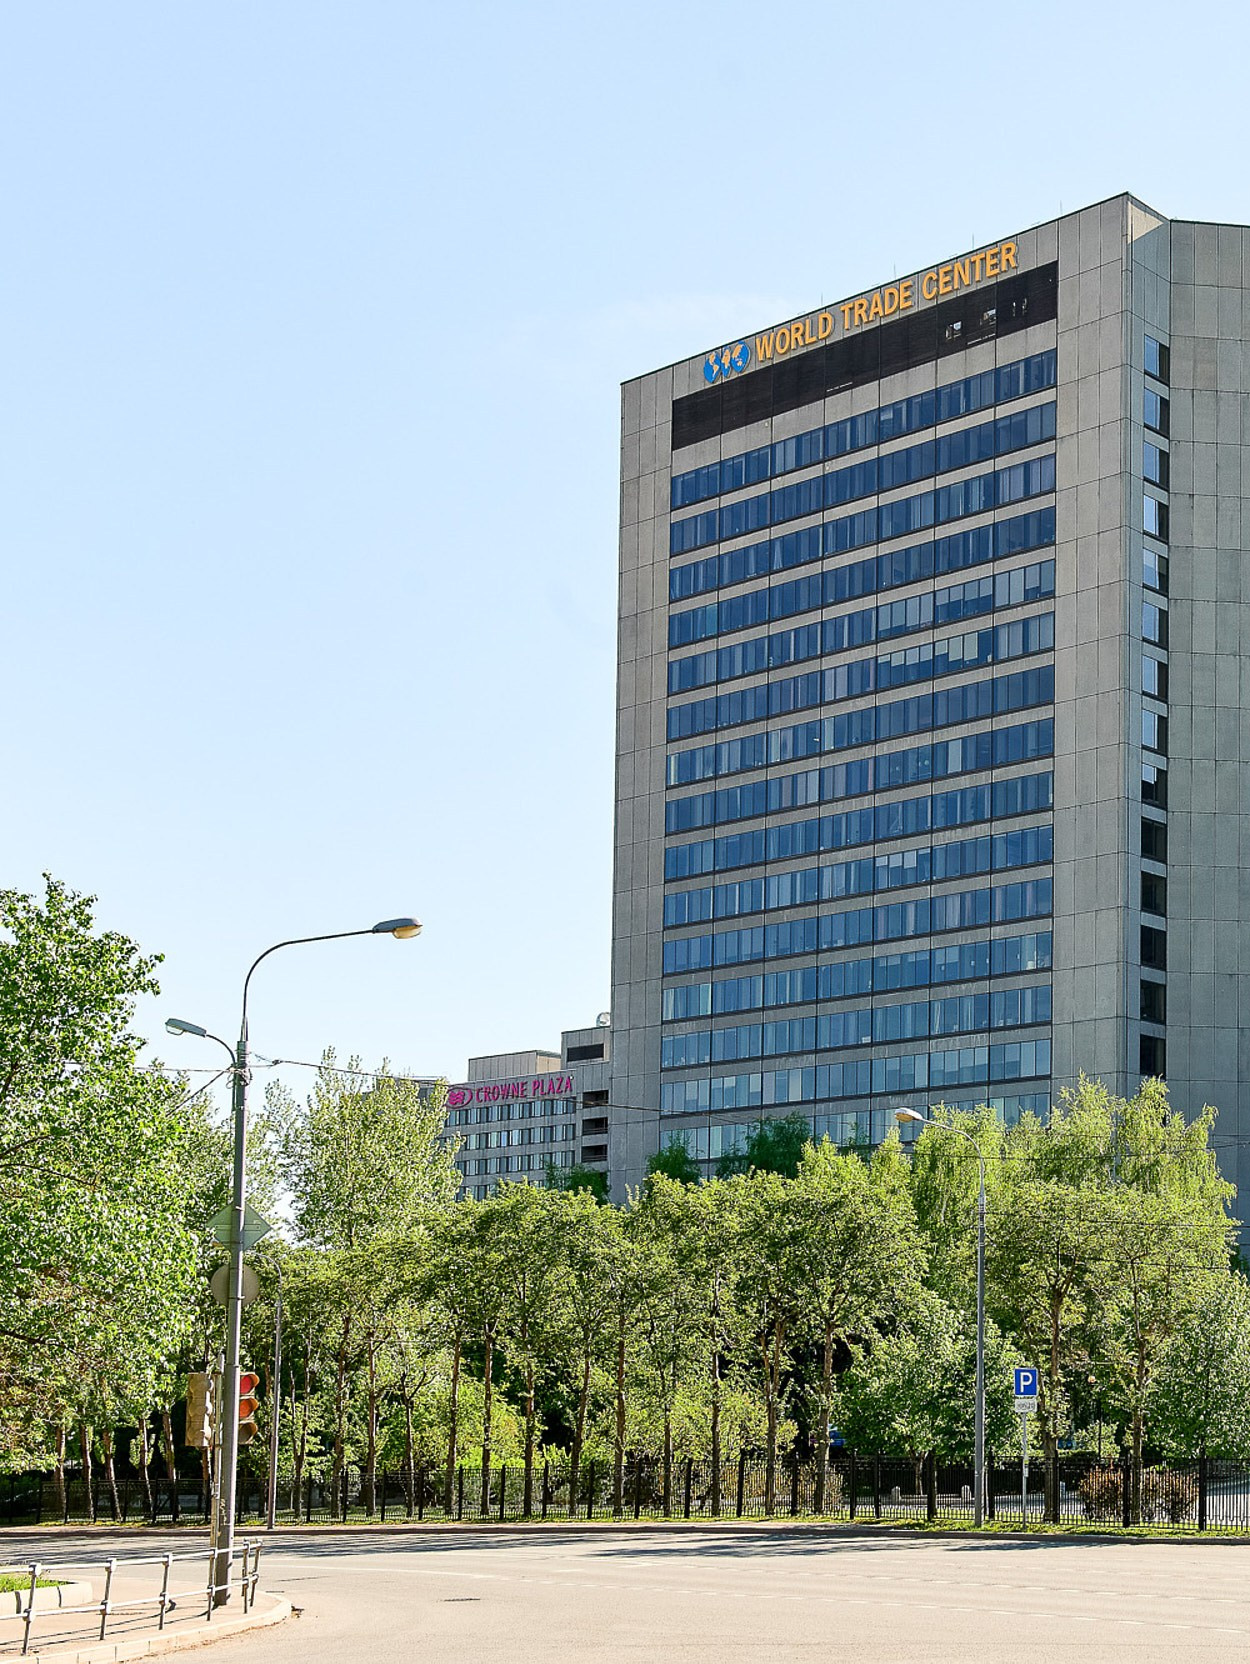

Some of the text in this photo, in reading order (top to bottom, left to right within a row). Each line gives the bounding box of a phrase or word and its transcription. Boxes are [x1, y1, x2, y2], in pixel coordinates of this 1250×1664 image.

[755, 241, 1018, 361] WORLD TRADE CENTER
[475, 1076, 572, 1102] CROWNE PLAZA
[1020, 1372, 1033, 1393] P
